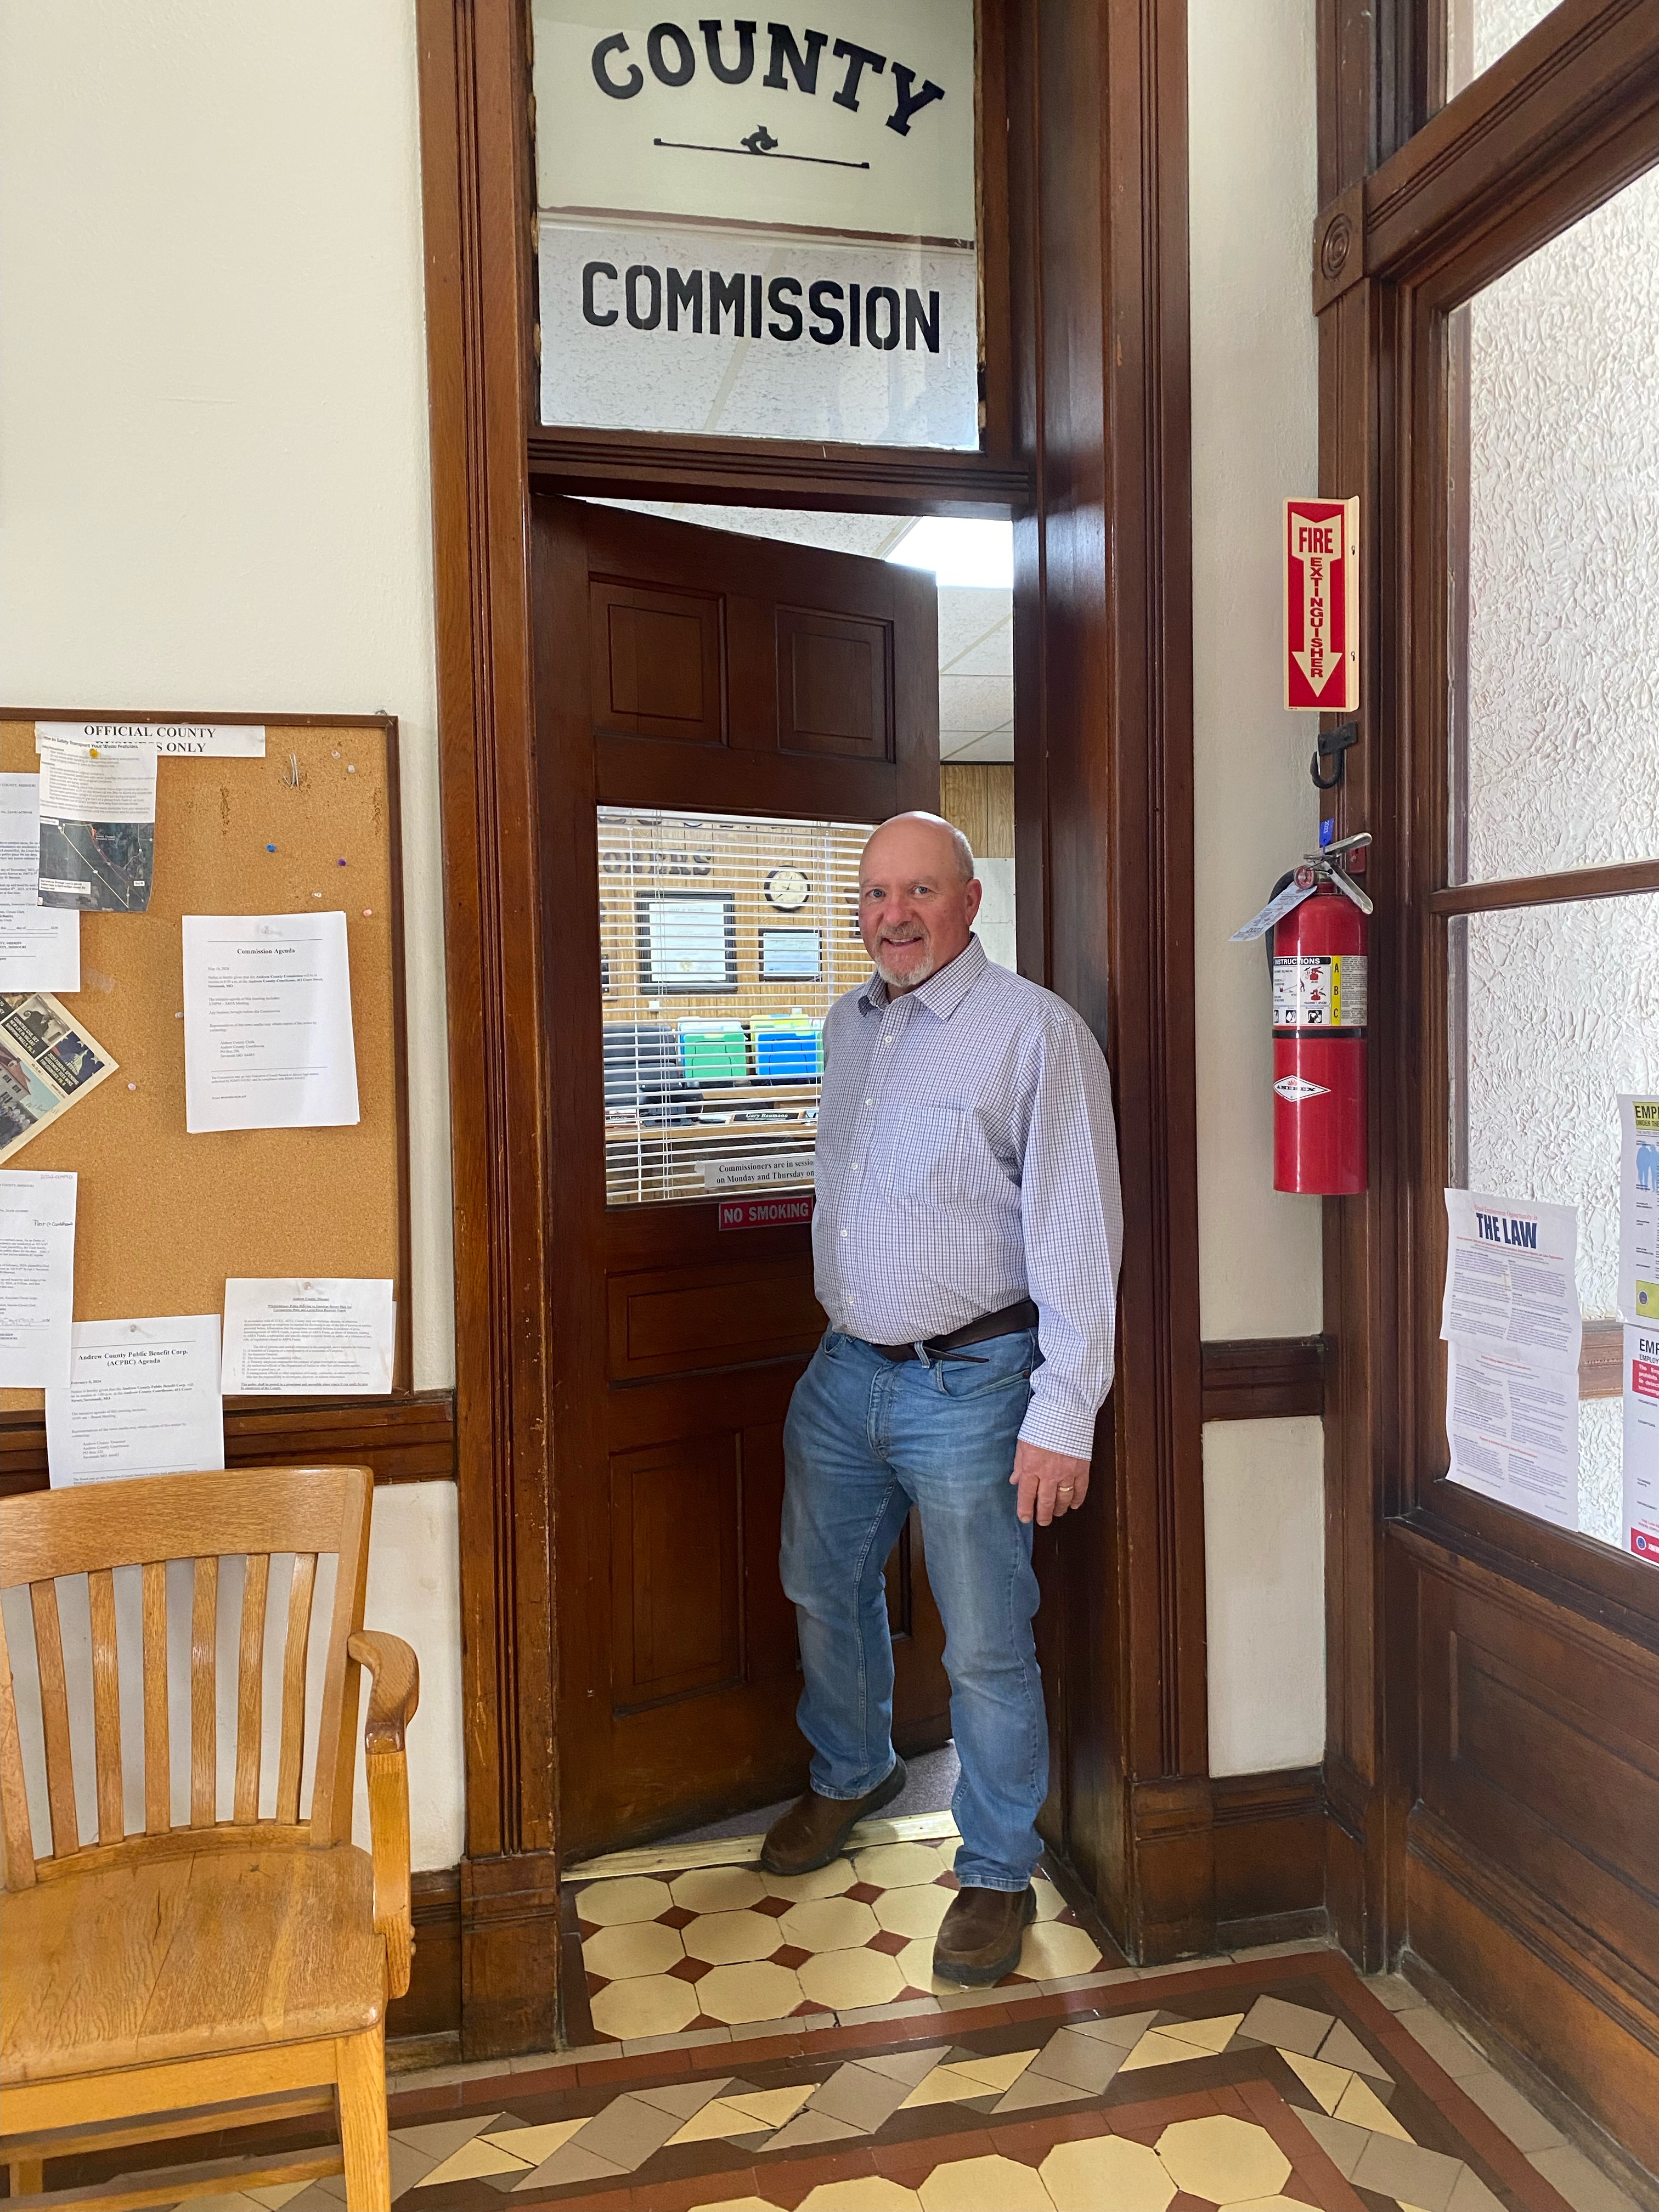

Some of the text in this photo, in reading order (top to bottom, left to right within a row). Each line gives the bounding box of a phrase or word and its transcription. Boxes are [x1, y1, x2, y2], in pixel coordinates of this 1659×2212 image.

[591, 19, 945, 136] COUNTY
[583, 261, 940, 353] COMMISSION
[1299, 527, 1334, 554] FIRE
[1310, 557, 1324, 678] EXTINGUISHER
[84, 725, 216, 738] OFFICIAL COUNTY
[167, 742, 206, 752] ONLY
[1334, 963, 1339, 973] A
[1334, 986, 1339, 995] B
[1334, 1008, 1339, 1018] C
[1635, 1105, 1659, 1119] EMP
[719, 1164, 772, 1173] Commissioners
[727, 1175, 755, 1183] Monday
[772, 1171, 805, 1180] Thursday
[724, 1202, 809, 1224] NO SMOKING
[1476, 1212, 1538, 1249] THE LAW
